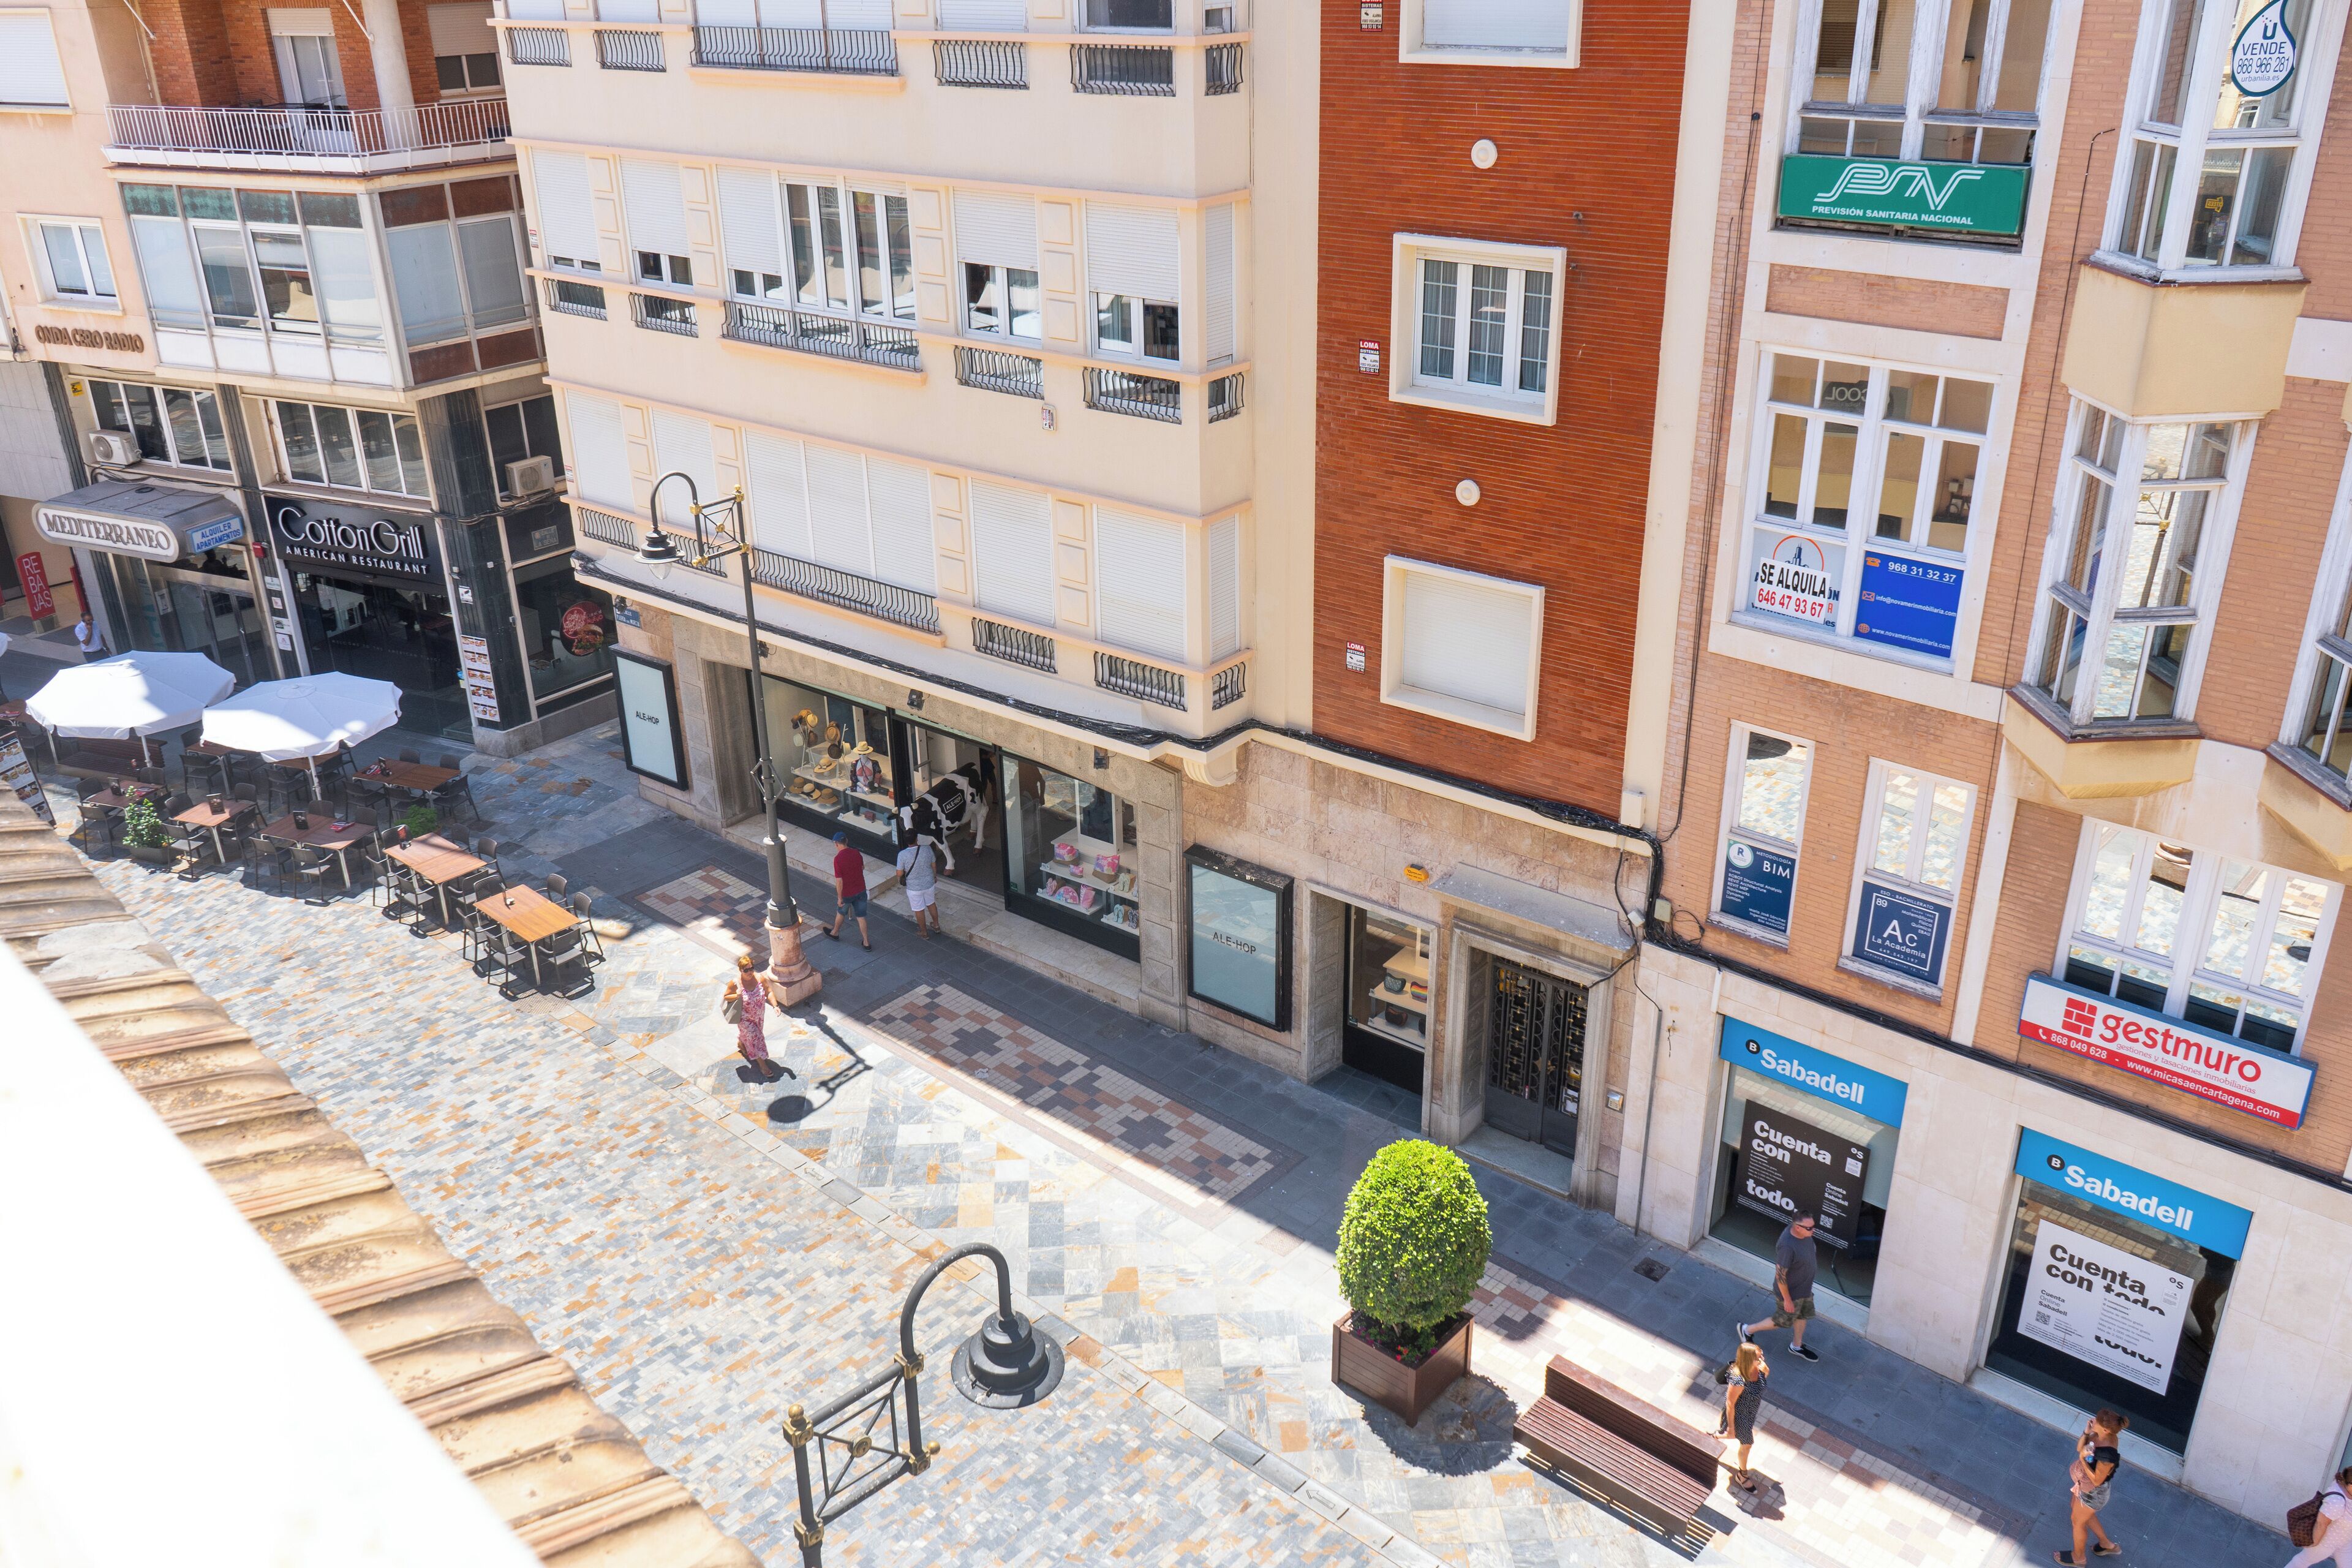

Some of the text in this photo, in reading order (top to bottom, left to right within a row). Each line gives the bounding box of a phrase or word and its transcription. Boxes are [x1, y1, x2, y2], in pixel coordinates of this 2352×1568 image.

[2242, 42, 2287, 55] VENDE
[2237, 56, 2290, 75] 868 966 281
[1812, 205, 1973, 225] PREVISIÓN SANITARIA NACIONAL
[35, 325, 145, 353] ONDA CERO RADIO
[43, 513, 171, 550] MEDITERRANEO
[196, 529, 241, 551] APARTAMENTOS
[201, 522, 232, 539] ALQUILER
[22, 556, 40, 576] RE
[286, 545, 428, 575] AMERICAN RESTAURANT
[1760, 562, 1775, 586] SE
[1776, 567, 1826, 598] ALQUILA
[1888, 562, 1956, 582] 968 31 32 37
[28, 575, 45, 594] BA
[34, 590, 53, 611] JAS
[1758, 588, 1776, 606] 646
[1779, 594, 1792, 610] 47
[1795, 598, 1807, 614] 93
[1811, 601, 1824, 618] 67
[1875, 594, 1956, 617] info@novamerinmobiliaria.com
[1348, 642, 1365, 652] LOMA
[1872, 628, 1950, 650] www.novamerinmobiliaria.com
[636, 710, 659, 725] ALE-HOP
[946, 797, 962, 810] ALE-HOP
[1737, 847, 1744, 858] R
[1757, 851, 1792, 865] METODOLOGÍA
[1763, 860, 1790, 878] BIM
[1726, 891, 1744, 899] Dynamo
[1727, 886, 1750, 897] Navisworks
[1741, 881, 1766, 893] Architecture
[1765, 884, 1782, 894] Analysis
[1726, 894, 1741, 903] Lumion
[1875, 898, 1888, 908] 89
[1896, 894, 1934, 910] BACHILLERATO
[1765, 921, 1785, 930] MANAGER
[1901, 910, 1933, 923] Matemáticas
[1883, 919, 1918, 947] Ac
[1911, 922, 1932, 932] Química
[1213, 932, 1256, 954] ALE-HOP
[1872, 935, 1926, 959] La Academia
[1879, 948, 1918, 963] 649.543.197
[2098, 1014, 2261, 1082] gestmuro
[1749, 1042, 1864, 1105] B Sabadell
[2051, 1033, 2068, 1046] 868
[2070, 1040, 2087, 1052] 049
[2090, 1046, 2107, 1058] 628
[2127, 1060, 2280, 1118] www.micasaencartagena.com
[2116, 1042, 2152, 1060] gestiones
[2161, 1057, 2201, 1076] tasaciones
[2204, 1069, 2256, 1095] inmobiliarias
[1752, 1138, 1791, 1164] con
[1754, 1120, 1831, 1165] Cuenta
[1825, 1187, 1842, 1198] Online
[1826, 1182, 1846, 1194] Cuenta
[2051, 1156, 2194, 1231] B Sabadell
[1824, 1192, 1849, 1207] Sabadell
[2046, 1264, 2094, 1292] con
[2049, 1244, 2146, 1295] Cuenta
[2040, 1295, 2061, 1307] Online
[2041, 1289, 2065, 1303] Cuenta
[2038, 1300, 2068, 1317] Sabadell
